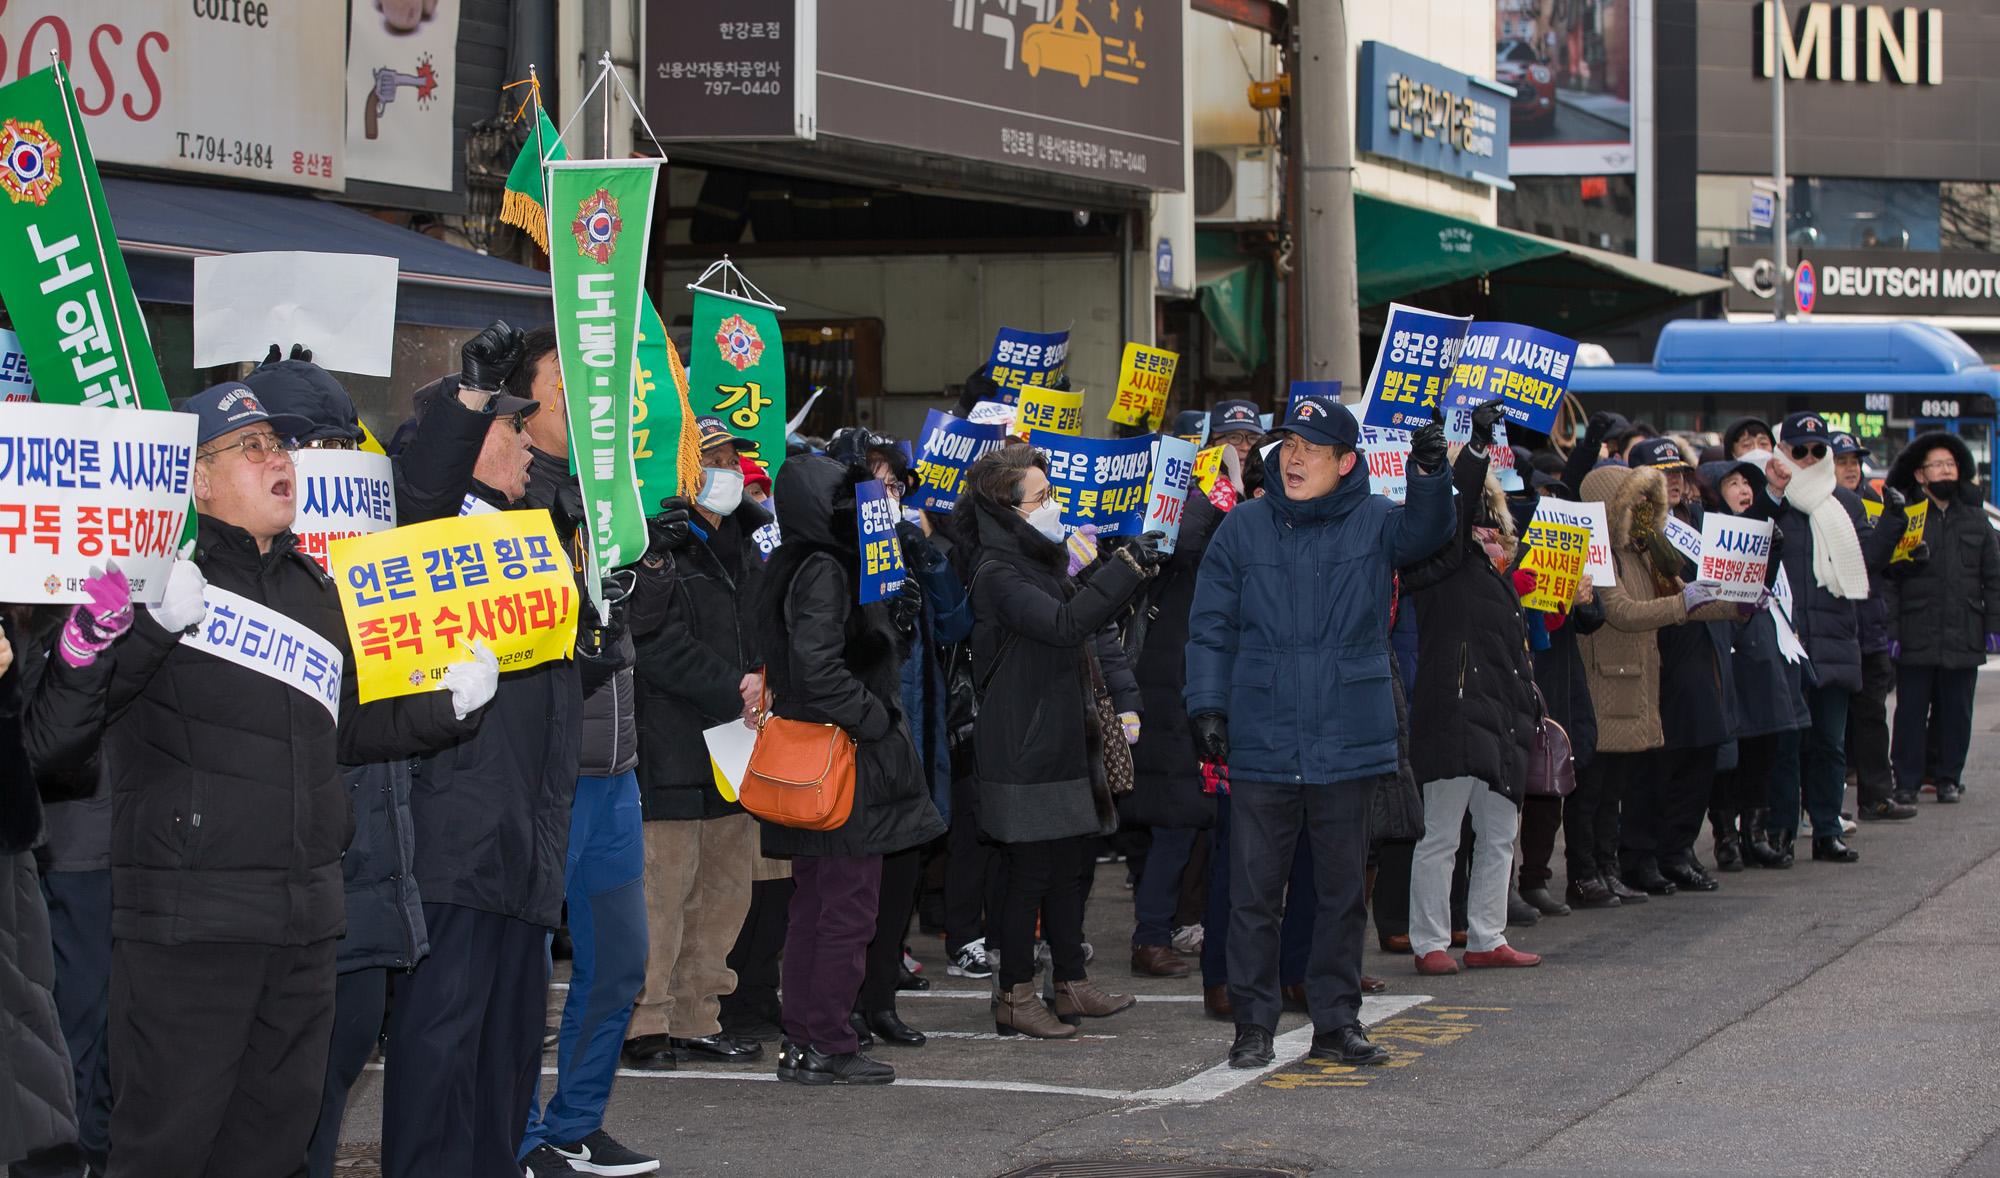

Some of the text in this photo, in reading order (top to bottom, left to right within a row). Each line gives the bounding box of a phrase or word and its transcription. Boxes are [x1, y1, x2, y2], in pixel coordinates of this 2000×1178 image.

[719, 22, 780, 39] 한강로점
[1763, 0, 1942, 85] MINI
[657, 61, 781, 78] 신용산자동차공업사
[704, 81, 780, 95] 797-0440
[176, 132, 274, 169] T.794-3484
[1002, 128, 1034, 157] 한강로점
[292, 151, 333, 178] 용산점
[1822, 266, 1939, 297] DEUTSCH
[997, 340, 1043, 367] 향군은
[1134, 351, 1175, 376] 본분망각
[1390, 330, 1438, 367] 향군은
[1501, 338, 1570, 380] 시사저널
[1129, 371, 1170, 396] 시사저널
[1380, 370, 1421, 403] 밥도
[1421, 376, 1440, 408] 못
[1490, 367, 1562, 410] 규탄한다!
[1023, 401, 1055, 428] 언론
[1119, 390, 1147, 413] 즉각
[1921, 400, 1960, 417] 8938
[924, 428, 976, 462] 사이비
[0, 437, 190, 494] 가짜언론 시사저널
[915, 459, 959, 492] 강력히
[1095, 450, 1149, 484] 청와대와
[1365, 452, 1404, 478] 사저널
[303, 476, 392, 522] 시사저널은
[1077, 490, 1098, 518] 못
[1101, 486, 1141, 515] 먹냐?
[1153, 493, 1181, 527] 기자
[0, 504, 183, 558] 구독 중단하자!
[1528, 527, 1584, 554] 본분망각
[1716, 529, 1770, 557] 시사저널
[348, 555, 417, 608] 언론
[422, 542, 490, 593] 갑질
[492, 535, 558, 580] 횡포
[866, 540, 891, 575] 밥도
[1531, 549, 1580, 575] 시사저널
[1703, 556, 1744, 583] 불법행위
[1553, 576, 1579, 600] 퇴출
[357, 586, 569, 661] 즉각 수사하라!
